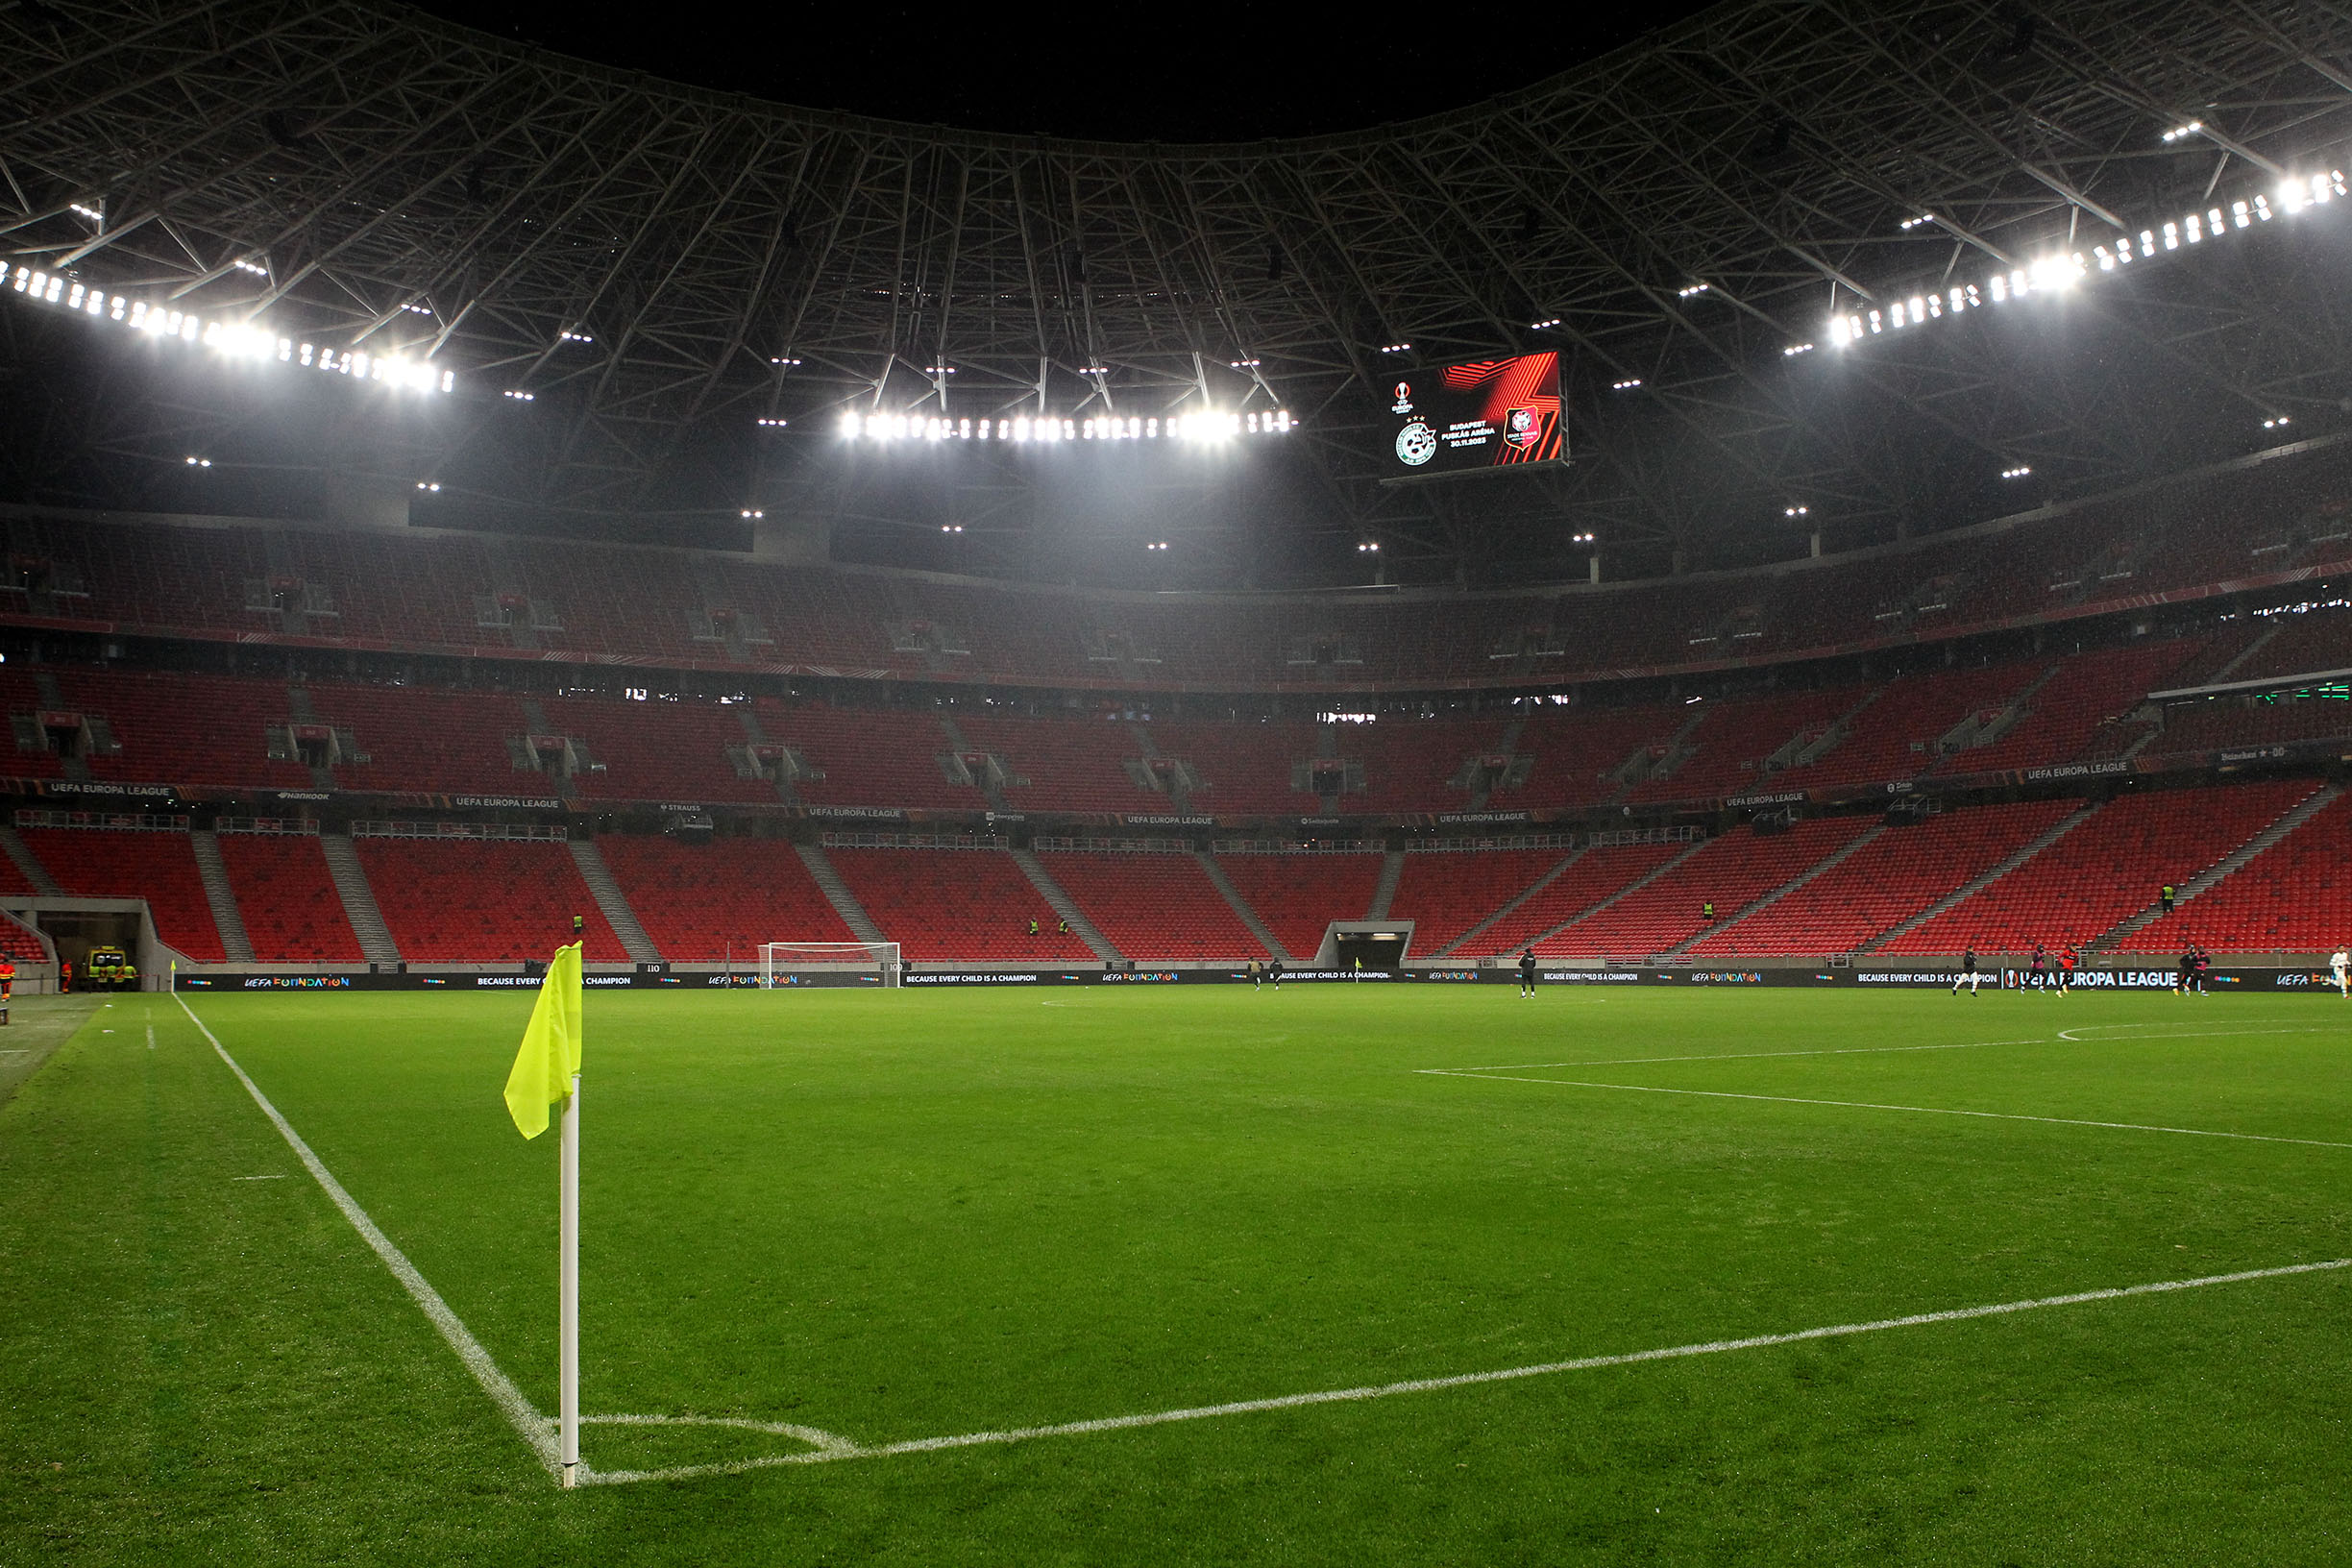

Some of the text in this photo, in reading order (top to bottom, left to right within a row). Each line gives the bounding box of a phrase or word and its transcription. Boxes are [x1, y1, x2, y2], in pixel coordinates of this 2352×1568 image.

[1449, 421, 1486, 431] BUDAPEST
[1450, 437, 1486, 448] 30.11.2023
[2028, 762, 2127, 779] UEFA EUROPA LEAGUE
[51, 783, 169, 796] UEFA EUROPA LEAGUE
[456, 797, 558, 808] UEFA EUROPA LEAGUE
[1727, 793, 1803, 807] UEFA EUROPA LEAGUE
[868, 809, 900, 818] LEAGUE
[1495, 813, 1526, 821] LEAGUE
[1149, 816, 1179, 824] EUROPA
[647, 964, 660, 972] 110
[478, 977, 515, 986] BECAUSE
[516, 977, 541, 986] EVERY
[1123, 973, 1178, 982] FOUNDATION
[1691, 972, 1709, 982] UEFA
[1858, 973, 1889, 982] BECAUSE
[1890, 973, 1913, 982] EVERY
[1913, 973, 1936, 982] CHILD
[1937, 973, 1945, 982] IS
[1946, 973, 1952, 982] A
[2118, 971, 2178, 986] LEAGUE
[2277, 974, 2309, 986] UEFA
[244, 977, 350, 988] UEFA FOUNDATION
